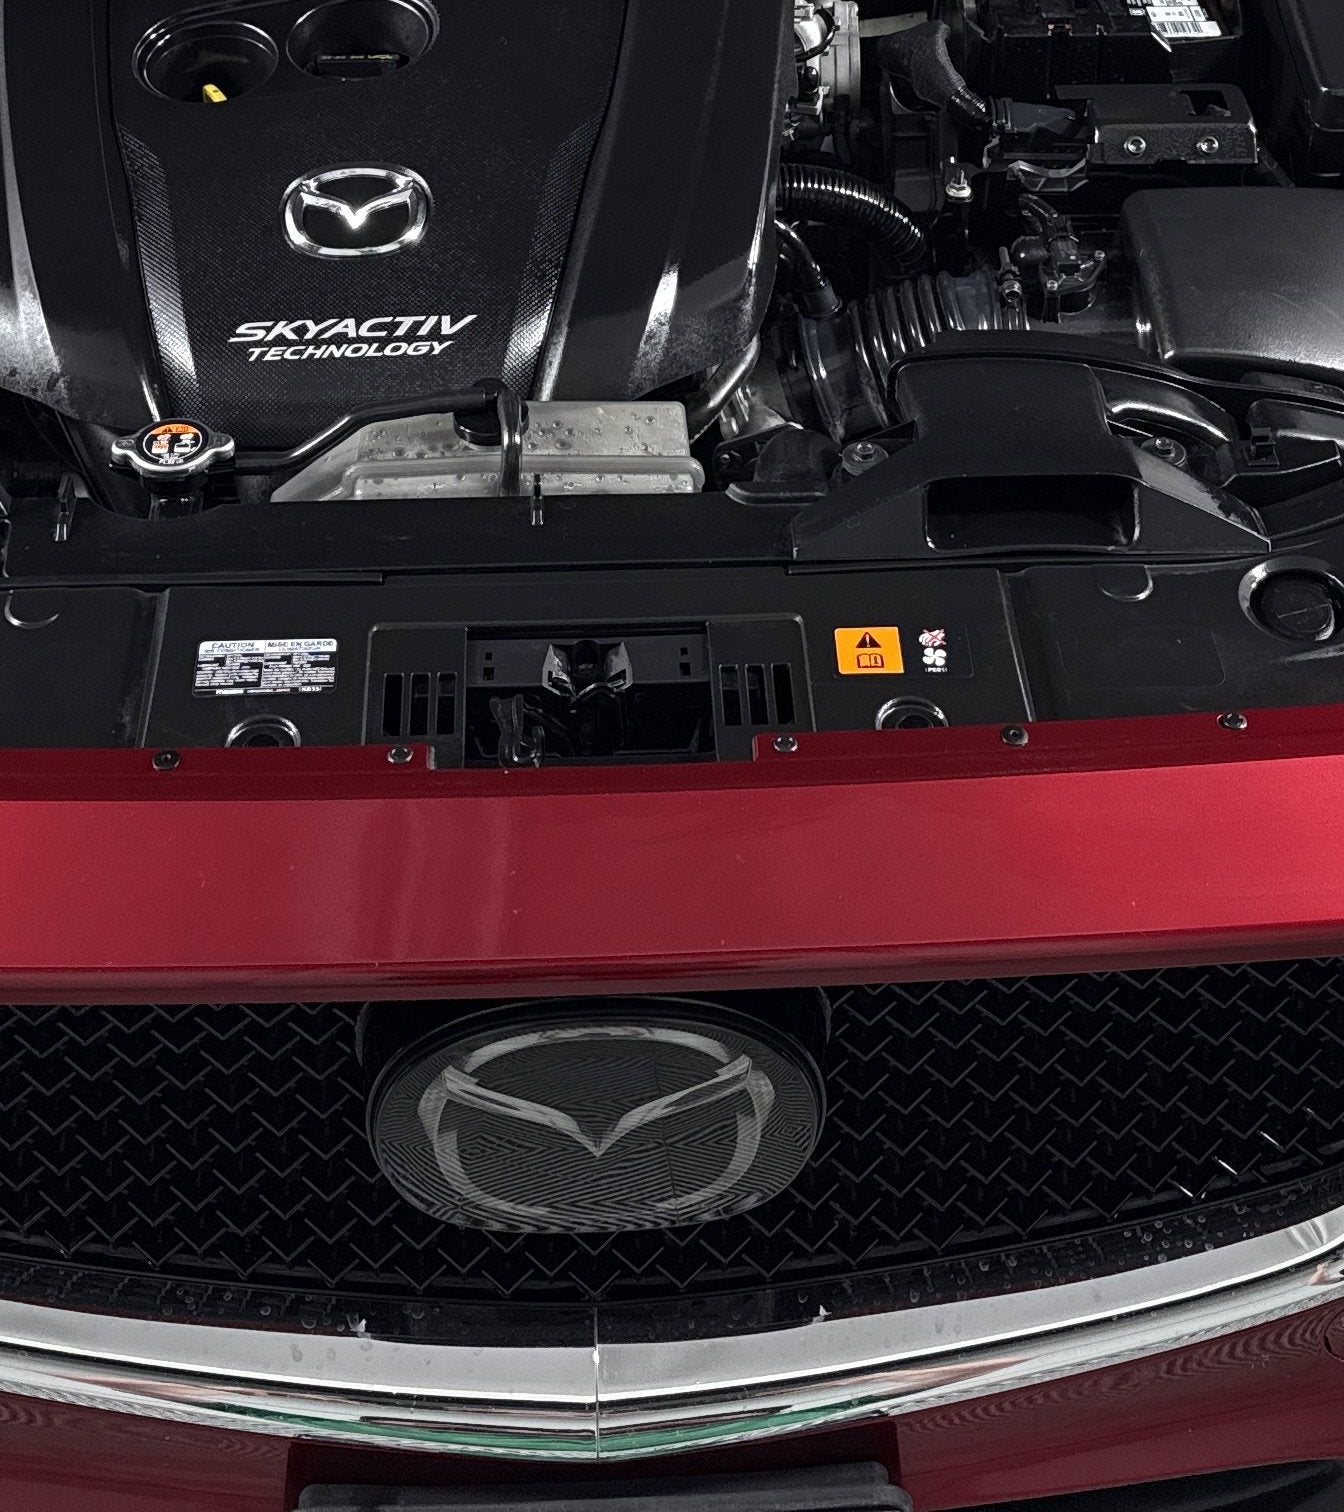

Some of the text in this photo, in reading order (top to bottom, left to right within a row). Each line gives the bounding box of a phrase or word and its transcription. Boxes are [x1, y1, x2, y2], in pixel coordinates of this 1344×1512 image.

[228, 314, 478, 343] SKYACTIV
[248, 340, 455, 362] TECHNOLOGY
[211, 641, 255, 649] CAUTION
